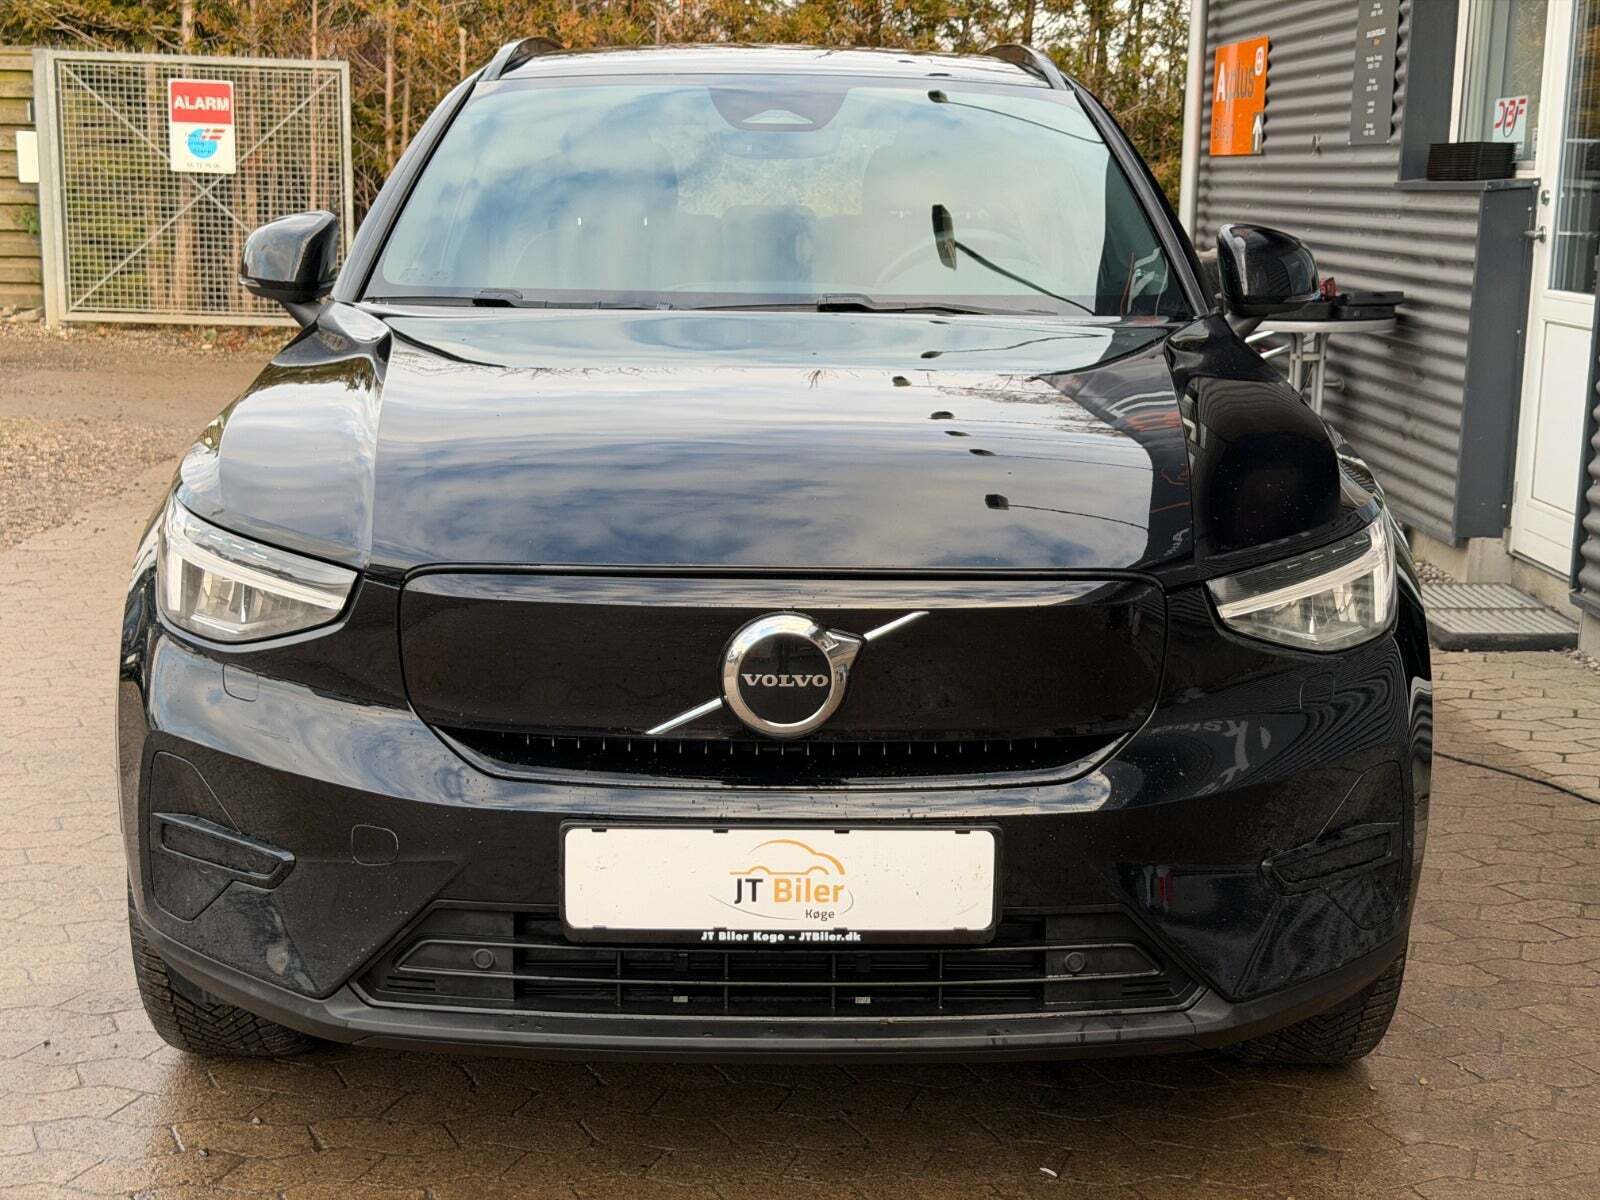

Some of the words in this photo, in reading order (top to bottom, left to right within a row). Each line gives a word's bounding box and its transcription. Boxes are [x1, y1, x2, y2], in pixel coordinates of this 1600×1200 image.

[174, 95, 229, 111] ALARM
[742, 673, 828, 687] VOLVO
[734, 878, 763, 904] JT
[773, 878, 844, 903] Biler
[805, 909, 835, 921] Køge
[701, 931, 714, 941] JT
[719, 931, 749, 941] Biler
[799, 931, 861, 941] JTBiler.dk
